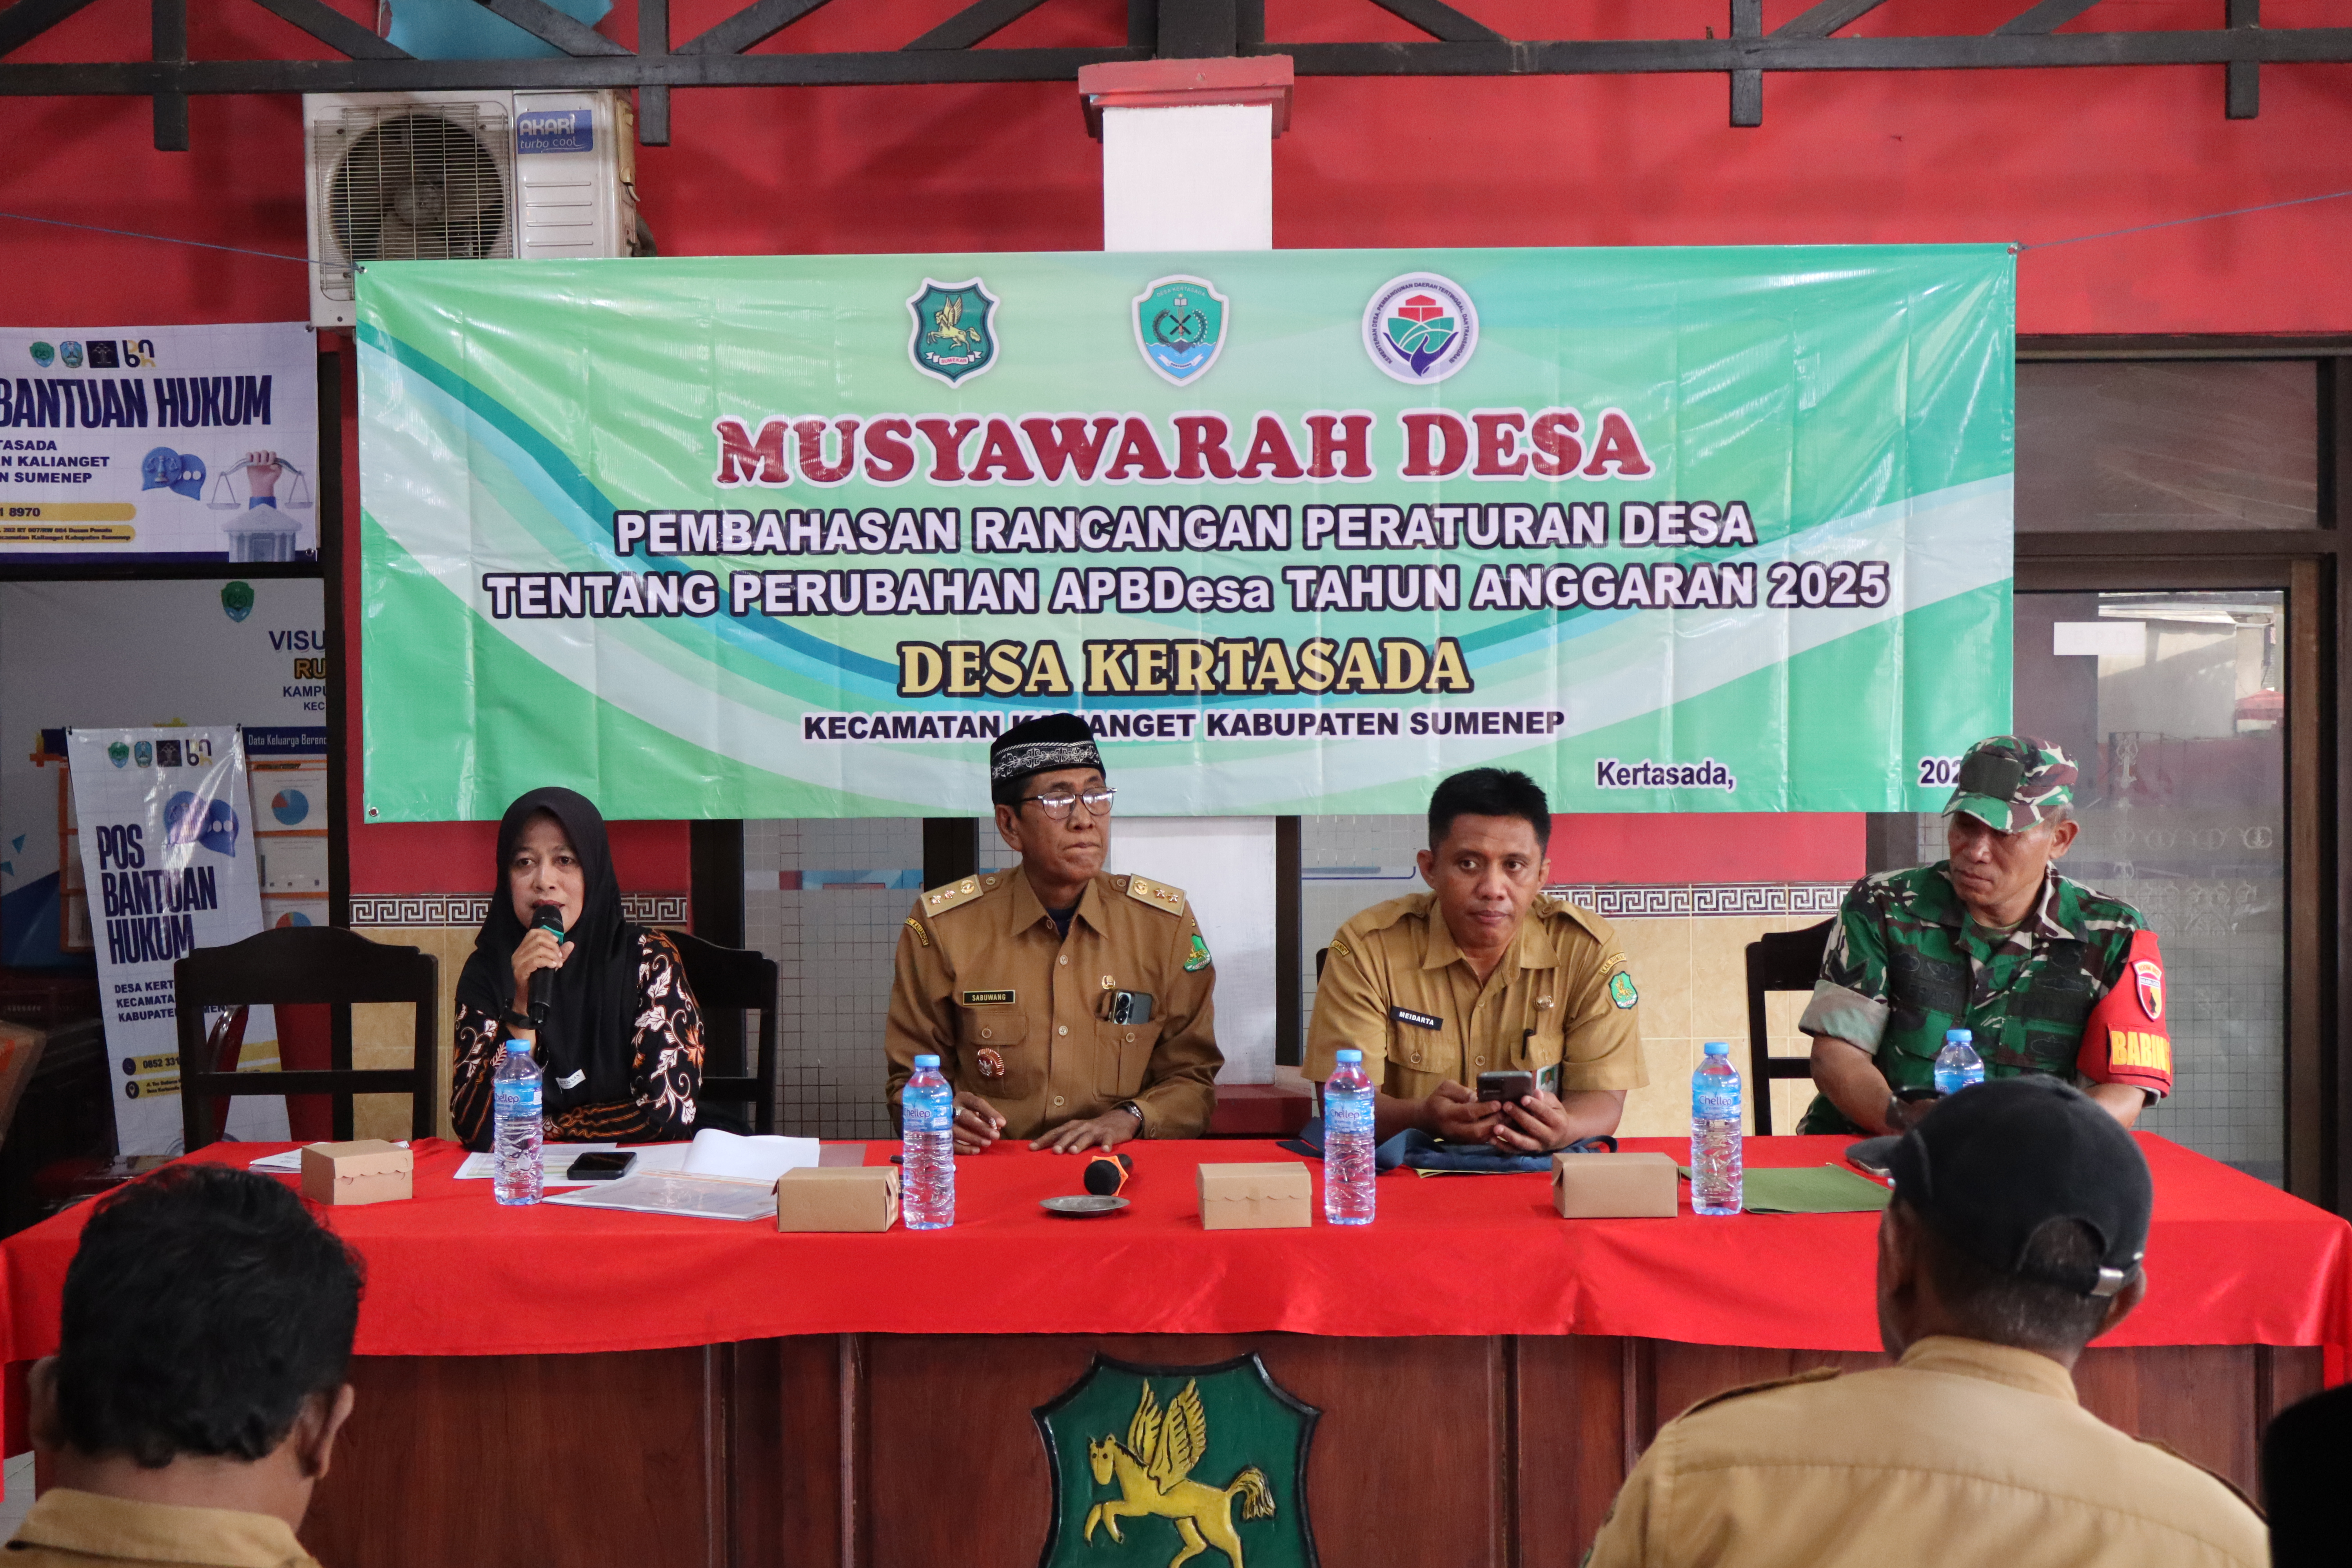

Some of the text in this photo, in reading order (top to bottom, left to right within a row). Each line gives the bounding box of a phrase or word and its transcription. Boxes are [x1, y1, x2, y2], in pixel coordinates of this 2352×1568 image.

[520, 113, 575, 136] AKARI
[521, 136, 584, 149] turbo cool
[1157, 286, 1205, 297] DESA KERTASADA
[1377, 283, 1413, 312] PEMBANGUNAN
[1372, 328, 1393, 364] KEMENTERIAN
[1449, 326, 1469, 364] TRANSMIGRASI
[154, 375, 272, 427] HUKUM
[716, 412, 1651, 484] MUSYAWARAH DESA
[18, 456, 110, 466] KALIANGET
[14, 472, 92, 483] SUMENEP
[9, 508, 40, 517] 8970
[614, 501, 1758, 556] PEMBAHASAN RANCANGAN PERATURAN DESA
[483, 560, 1891, 619] TENTANG PERUBAHAN APBDesa TAHUN ANGGARAN 2025
[897, 636, 1475, 698] DESA KERTASADA
[804, 711, 1565, 740] KECAMATAN KANGET KABUPATEN SUMENEP
[249, 735, 265, 745] Data
[267, 734, 299, 747] Keluarga
[1598, 759, 1961, 789] Kertasada, 202
[96, 824, 145, 870] POS
[102, 866, 217, 917] BANTUAN
[107, 914, 194, 964] HUKUM
[1610, 954, 1625, 963] SUMENE
[114, 980, 174, 994] DESA KERT
[116, 994, 175, 1008] KECAMATA
[118, 1008, 177, 1022] KABUPATE
[1399, 1011, 1434, 1025] MEIDARTA
[143, 1058, 163, 1069] 0852
[1699, 1096, 1732, 1106] Chellep
[1330, 1109, 1359, 1120] Chellep
